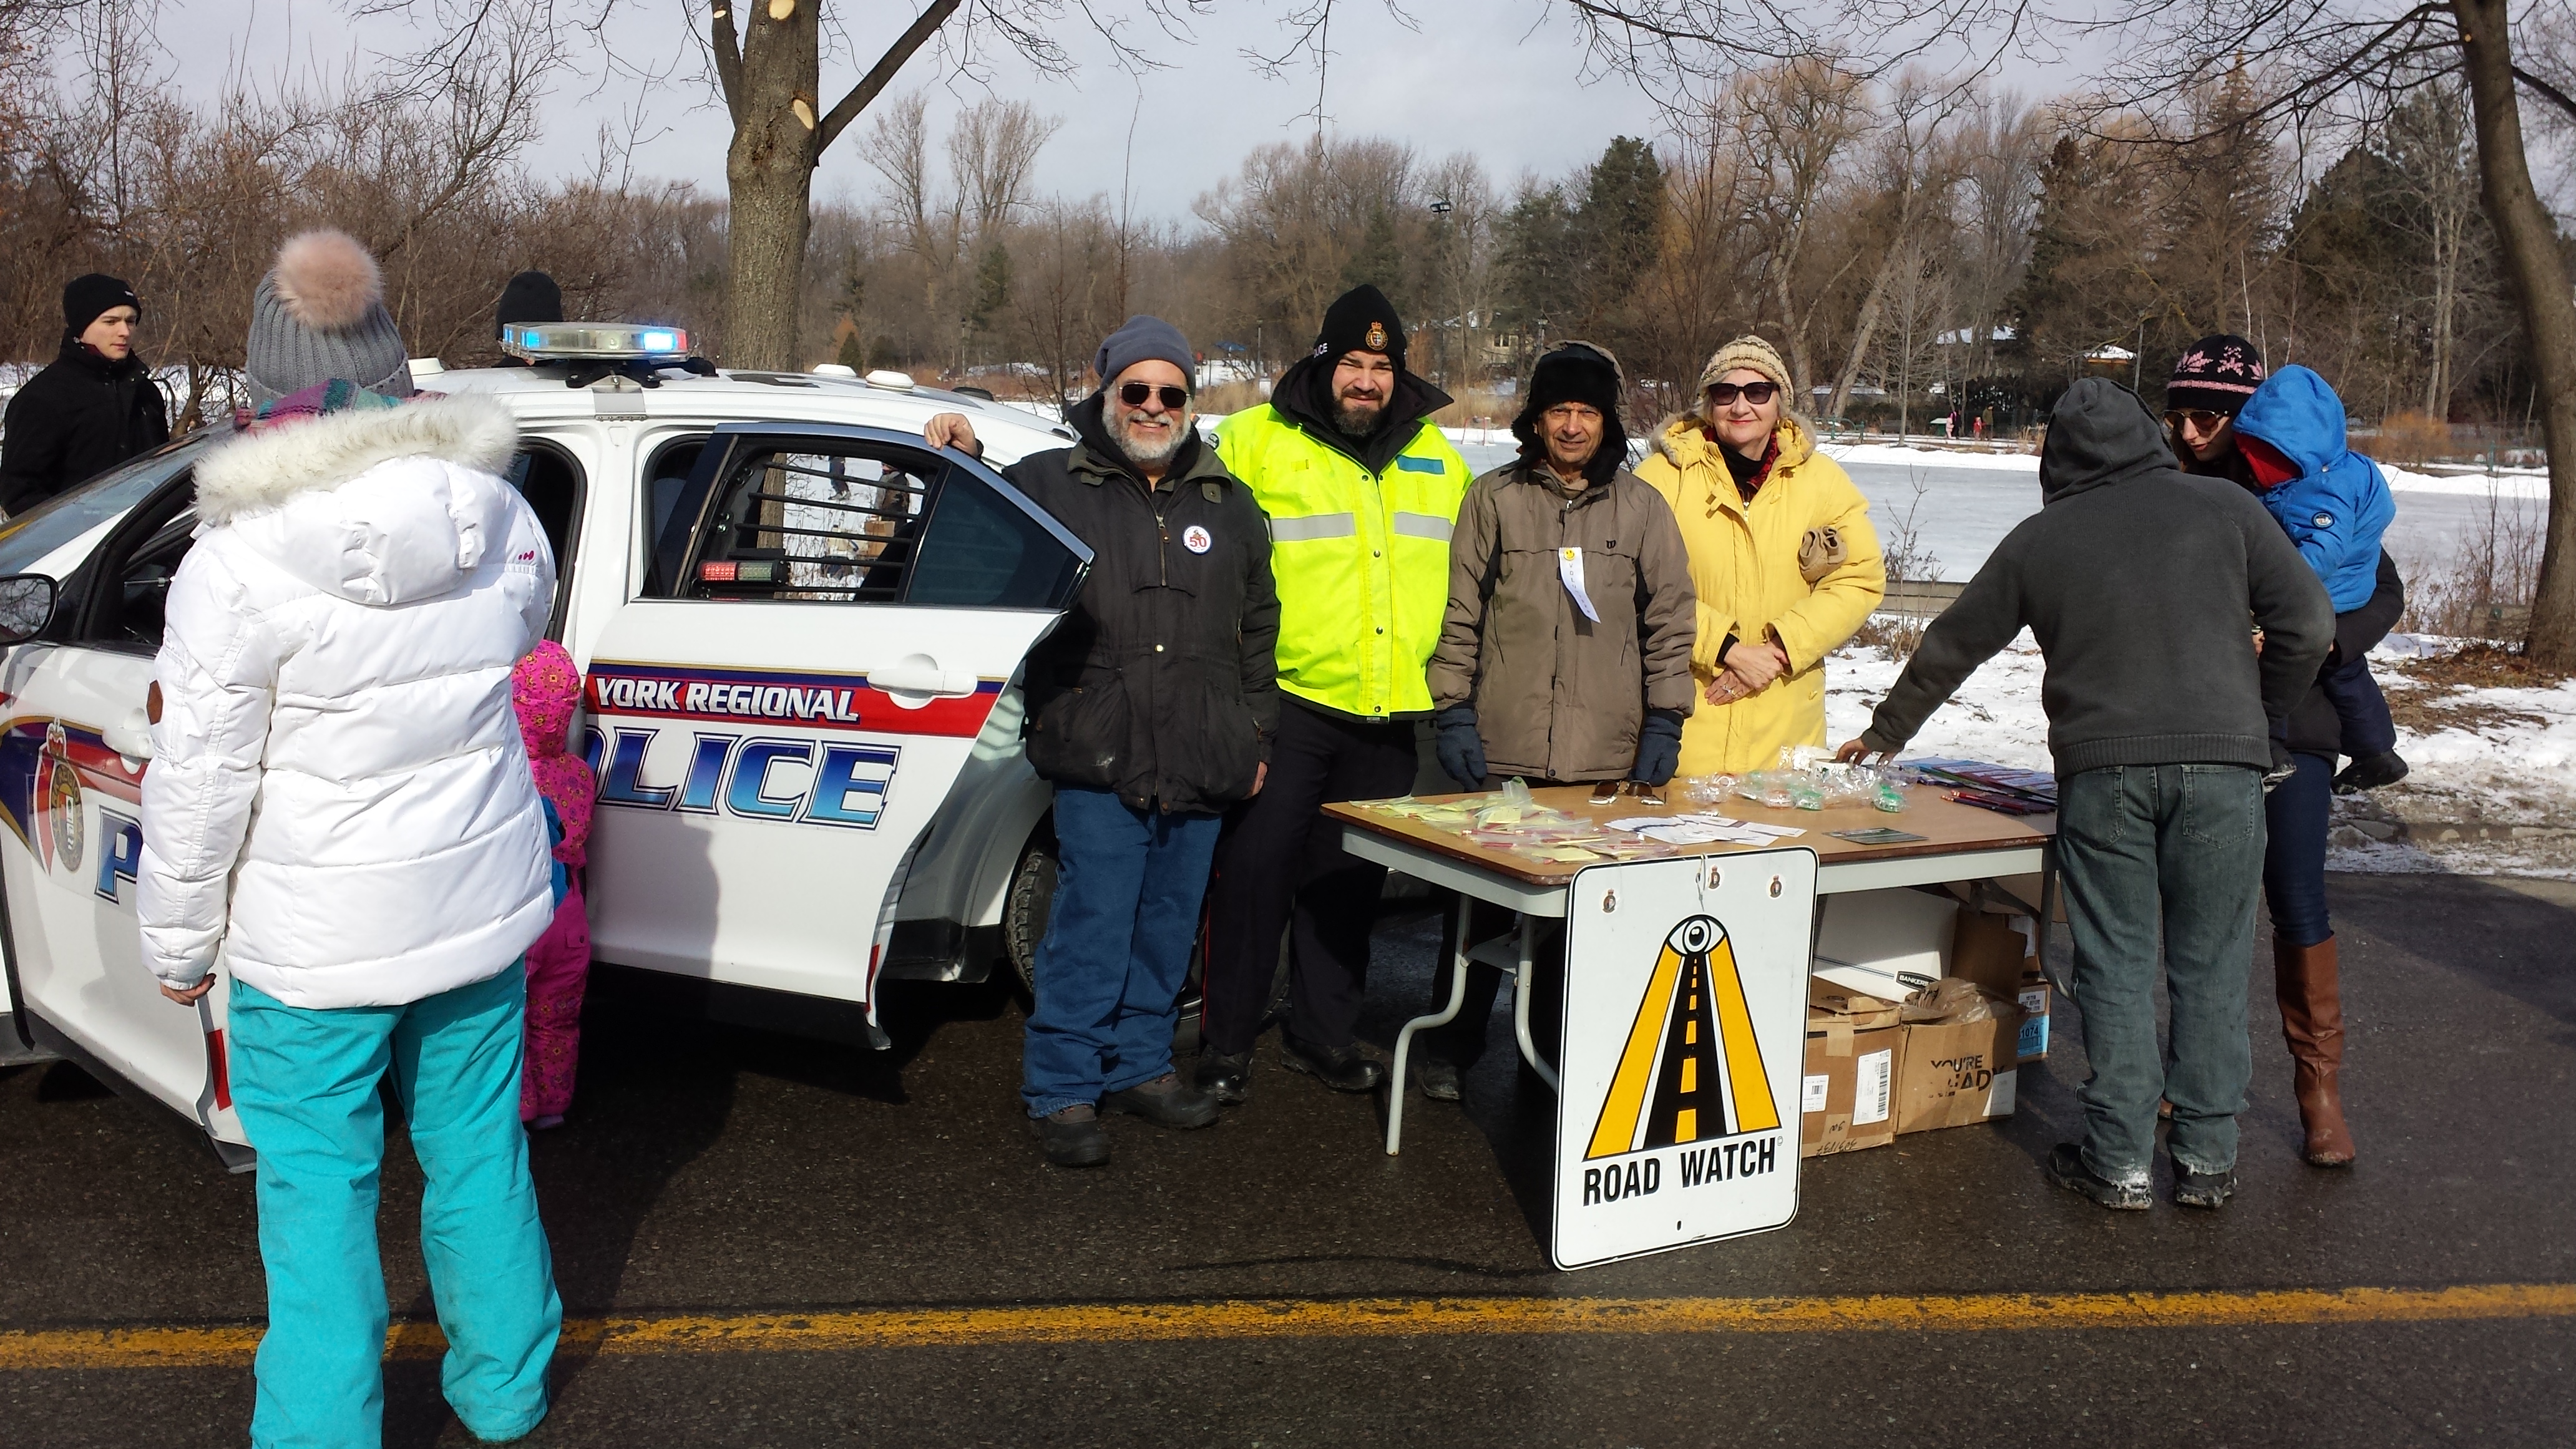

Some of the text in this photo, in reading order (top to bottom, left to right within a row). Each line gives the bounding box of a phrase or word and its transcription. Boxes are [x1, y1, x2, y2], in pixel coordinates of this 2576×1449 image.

[595, 678, 859, 721] YORK REGIONAL
[2019, 1025, 2039, 1038] 1074
[1583, 1137, 1776, 1207] ROAD WATCH
